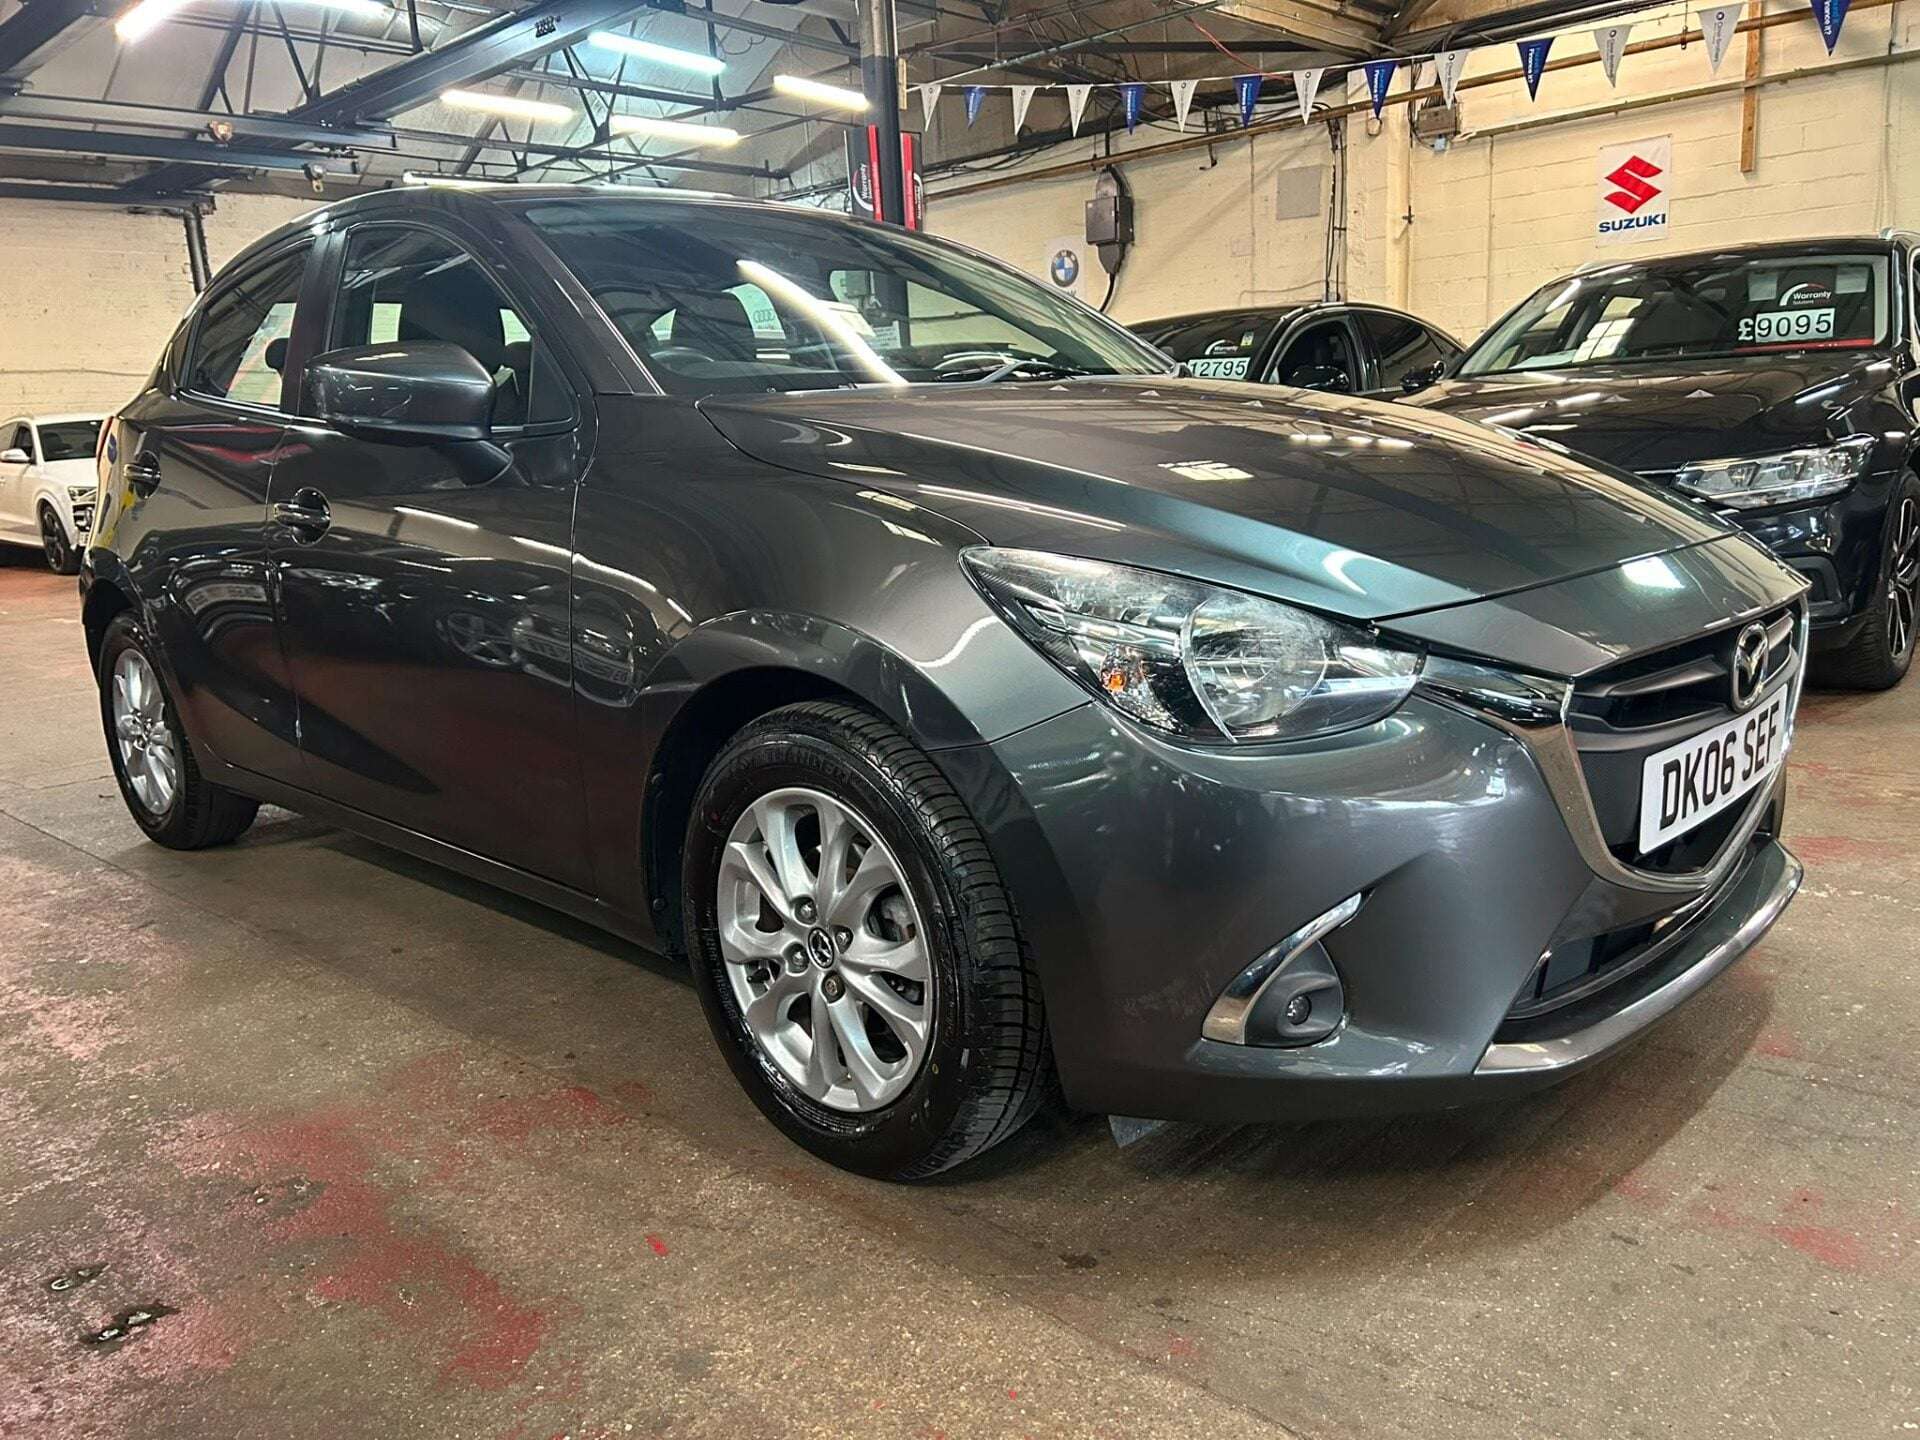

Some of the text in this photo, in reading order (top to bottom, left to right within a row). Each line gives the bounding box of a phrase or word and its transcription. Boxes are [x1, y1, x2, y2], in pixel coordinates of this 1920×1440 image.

[1599, 213, 1666, 233] SUZUKI
[1793, 290, 1831, 300] Warranty
[1738, 313, 1832, 341] £9095
[1190, 360, 1246, 377] 12795
[1659, 700, 1780, 831] DK06 SEF
